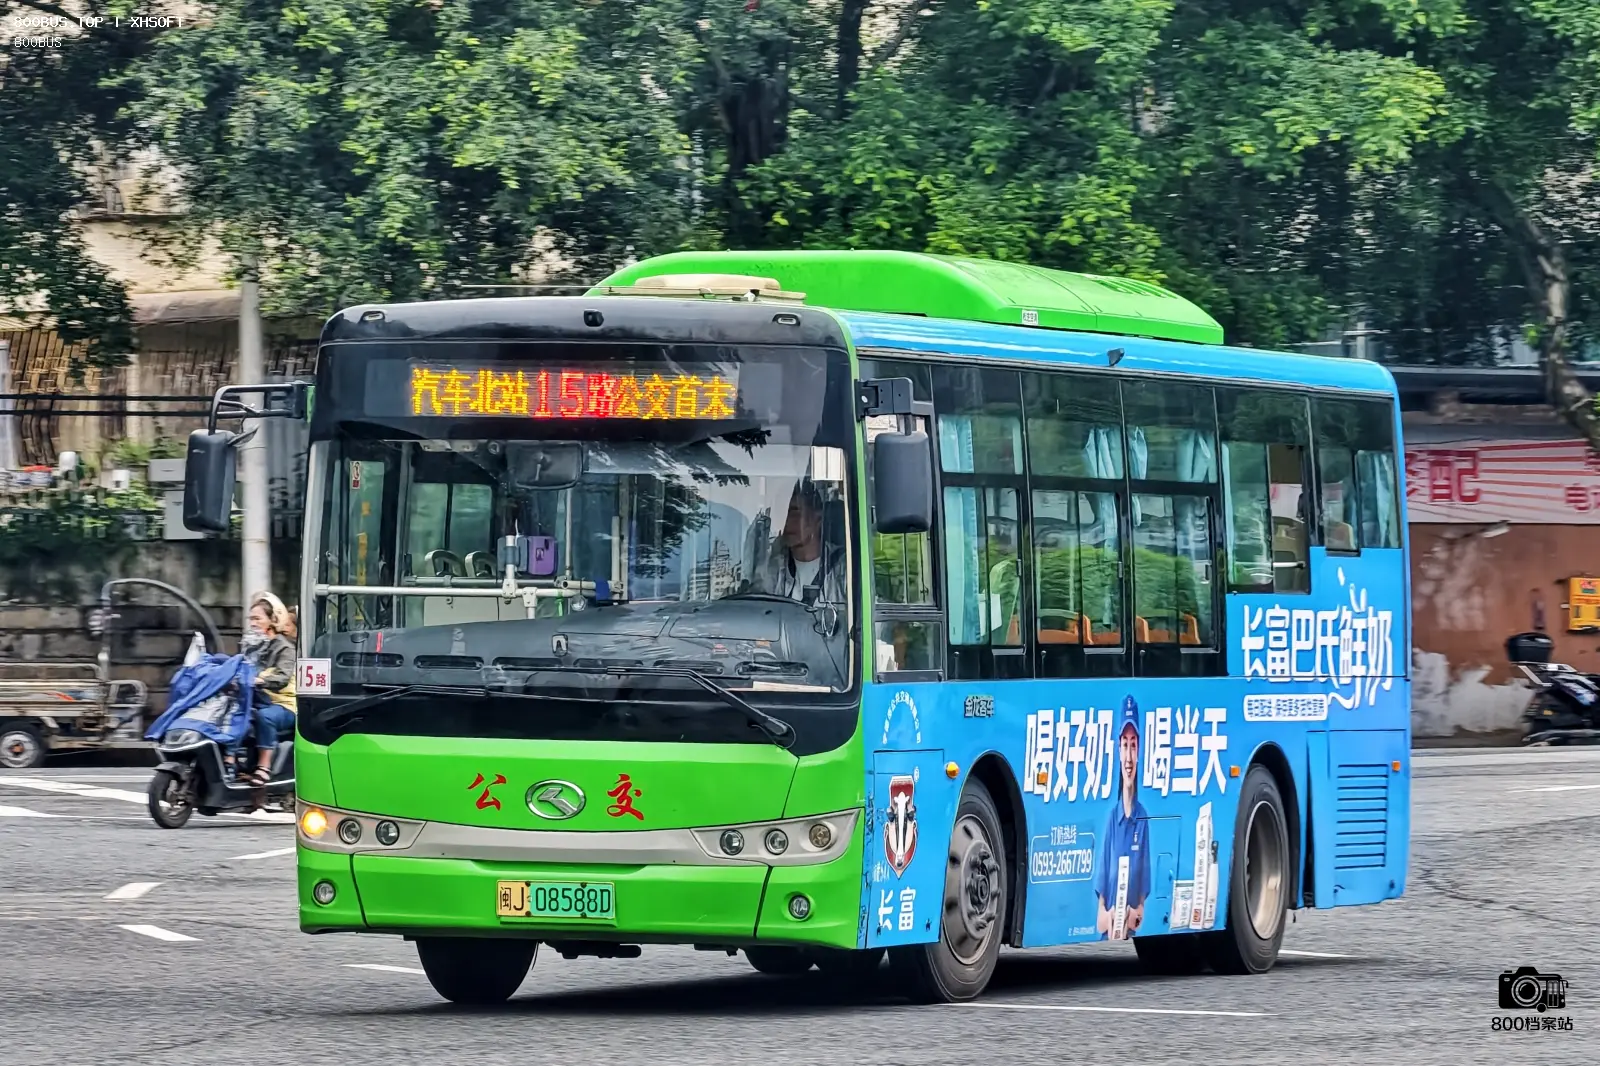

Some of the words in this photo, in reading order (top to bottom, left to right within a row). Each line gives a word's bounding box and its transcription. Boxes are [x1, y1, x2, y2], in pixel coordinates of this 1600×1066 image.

[1241, 584, 1394, 709] 长富巴氏鲜奶
[298, 664, 327, 688] 15路
[1023, 706, 1115, 803] 喝好奶
[1142, 704, 1228, 797] 喝当天
[467, 773, 507, 811] 公
[606, 773, 645, 821] 交
[1032, 848, 1093, 877] 0593-2667799
[878, 886, 917, 931] 长富
